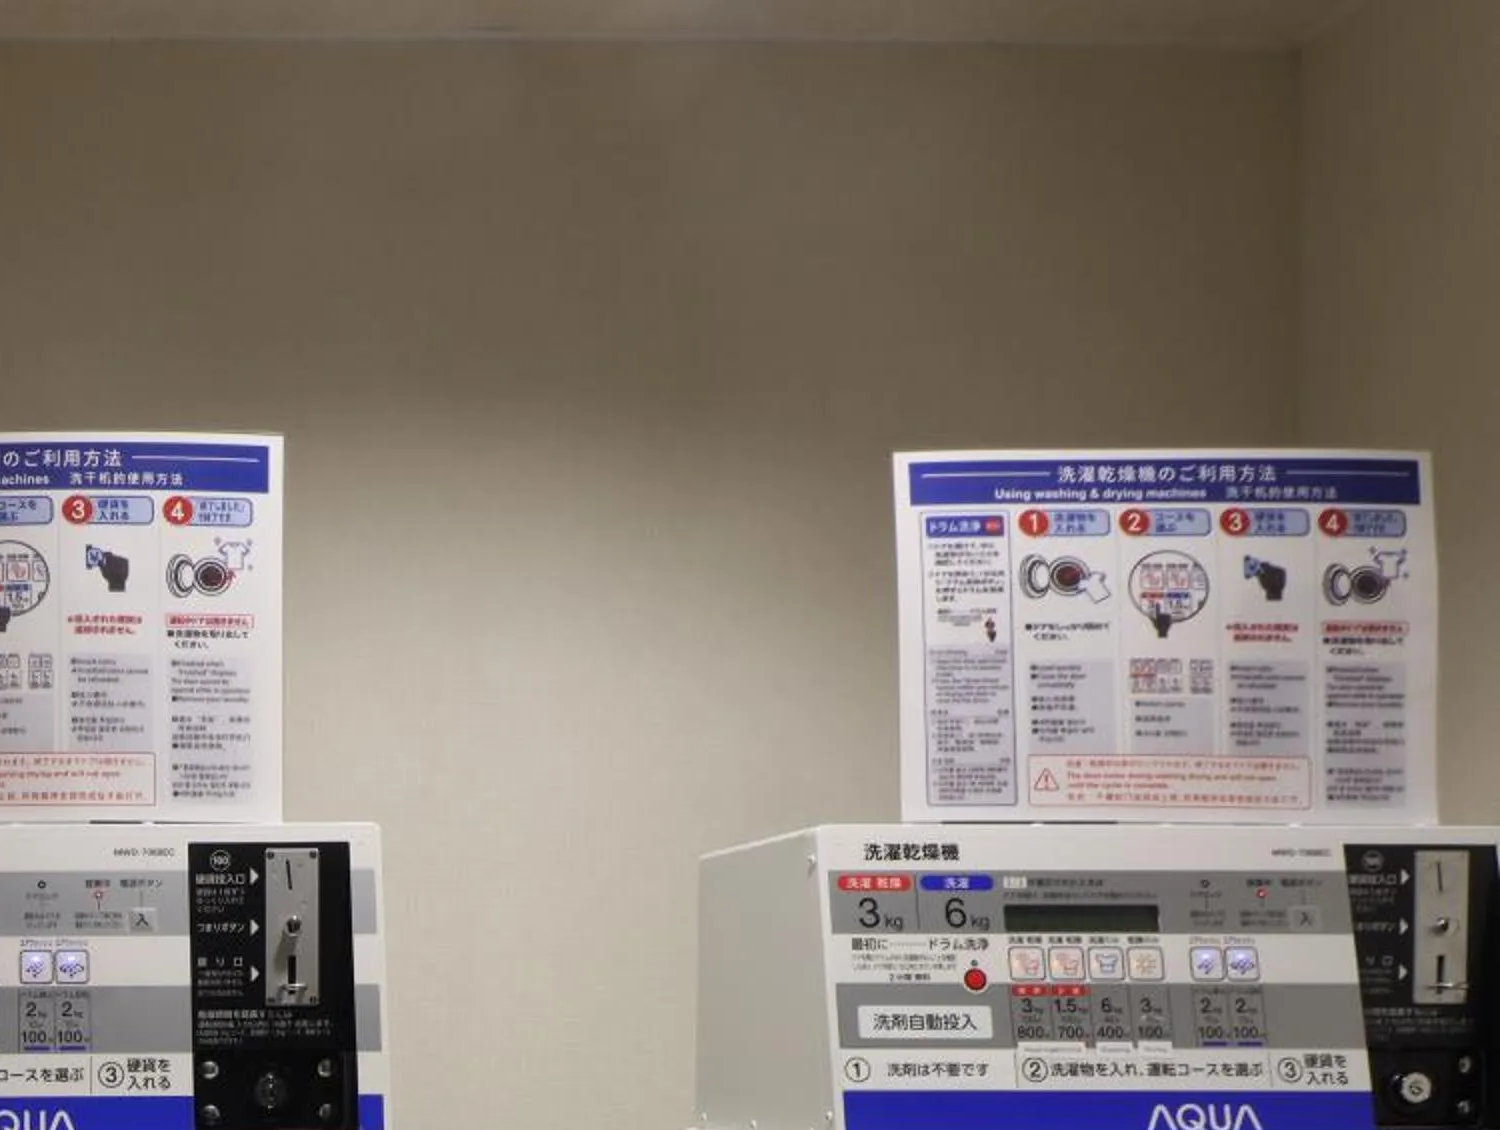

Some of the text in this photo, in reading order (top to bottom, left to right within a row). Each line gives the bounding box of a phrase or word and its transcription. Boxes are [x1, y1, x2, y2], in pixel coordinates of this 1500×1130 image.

[1057, 464, 1277, 483] 洗濯乾燥機のご利用方法
[994, 487, 1207, 501] Using washing & drying machines
[71, 499, 85, 520] 3
[170, 500, 185, 521] 4
[1128, 512, 1141, 532] 2
[1230, 512, 1243, 531] 3
[1327, 514, 1340, 532] 4
[864, 843, 960, 861] 洗濯乾燥機
[135, 913, 149, 927] 入
[873, 1013, 977, 1032] 洗剤自動投入
[127, 1058, 172, 1073] 硬貨を
[1051, 1061, 1264, 1078] 洗濯物を入れ、運転コースを選ぶ
[1304, 1053, 1347, 1069] 硬貨を
[886, 1062, 989, 1078] 洗剤は不要です
[1306, 1070, 1349, 1086] 入れる
[127, 1075, 172, 1091] 入れる
